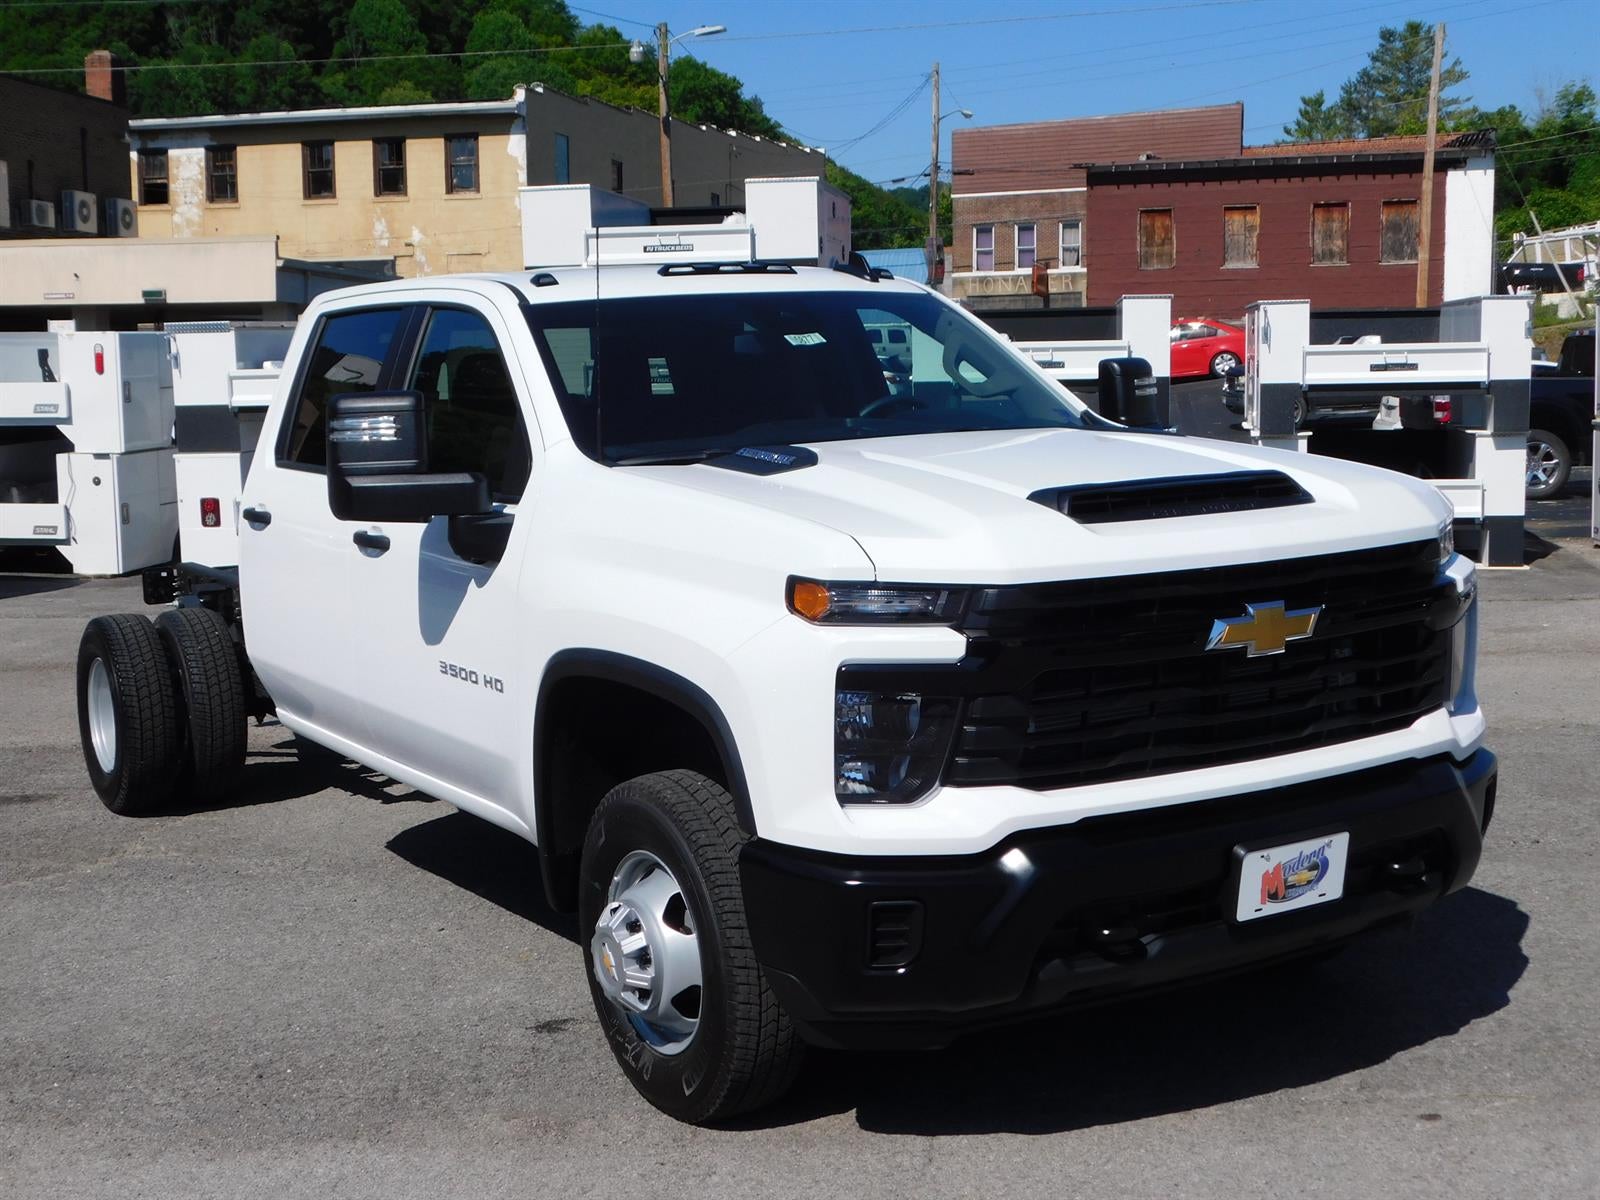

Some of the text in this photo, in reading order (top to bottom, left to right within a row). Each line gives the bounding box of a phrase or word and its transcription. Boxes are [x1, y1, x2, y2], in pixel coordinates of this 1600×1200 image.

[969, 274, 1073, 294] HONAER
[439, 660, 504, 694] 3500 HD
[1260, 845, 1326, 905] Modern
